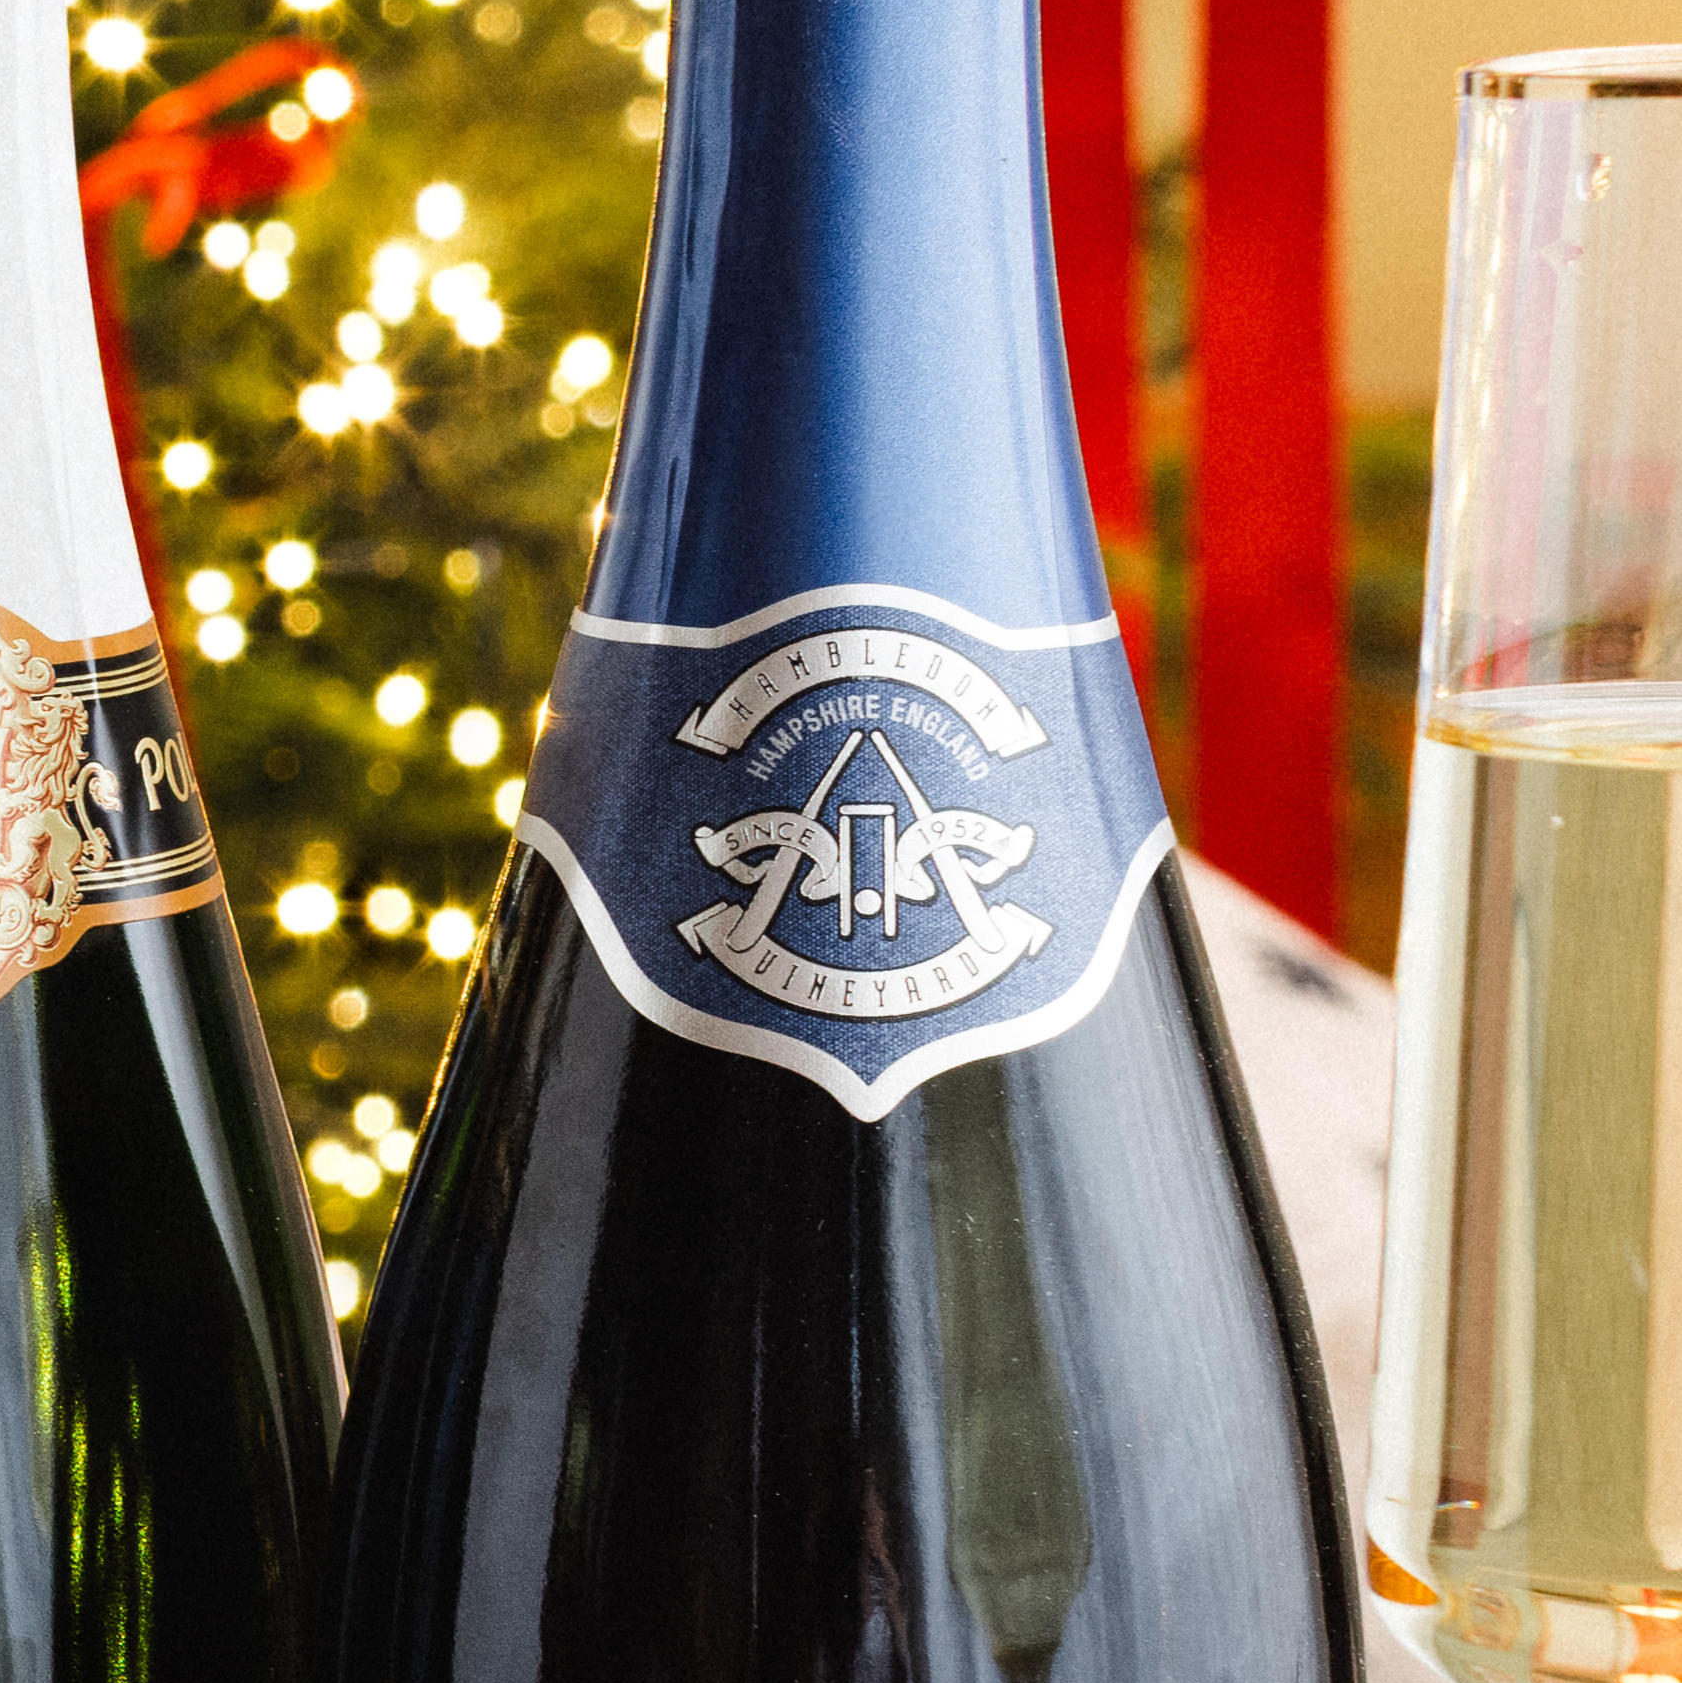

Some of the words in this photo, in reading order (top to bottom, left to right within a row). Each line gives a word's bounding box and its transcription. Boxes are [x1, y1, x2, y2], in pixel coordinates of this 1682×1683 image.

[728, 640, 999, 720] HAMBLEDON
[746, 696, 880, 782] HAMPSHIRE
[891, 697, 989, 782] ENGLAND
[725, 822, 815, 851] SINCE
[918, 822, 986, 845] 1952
